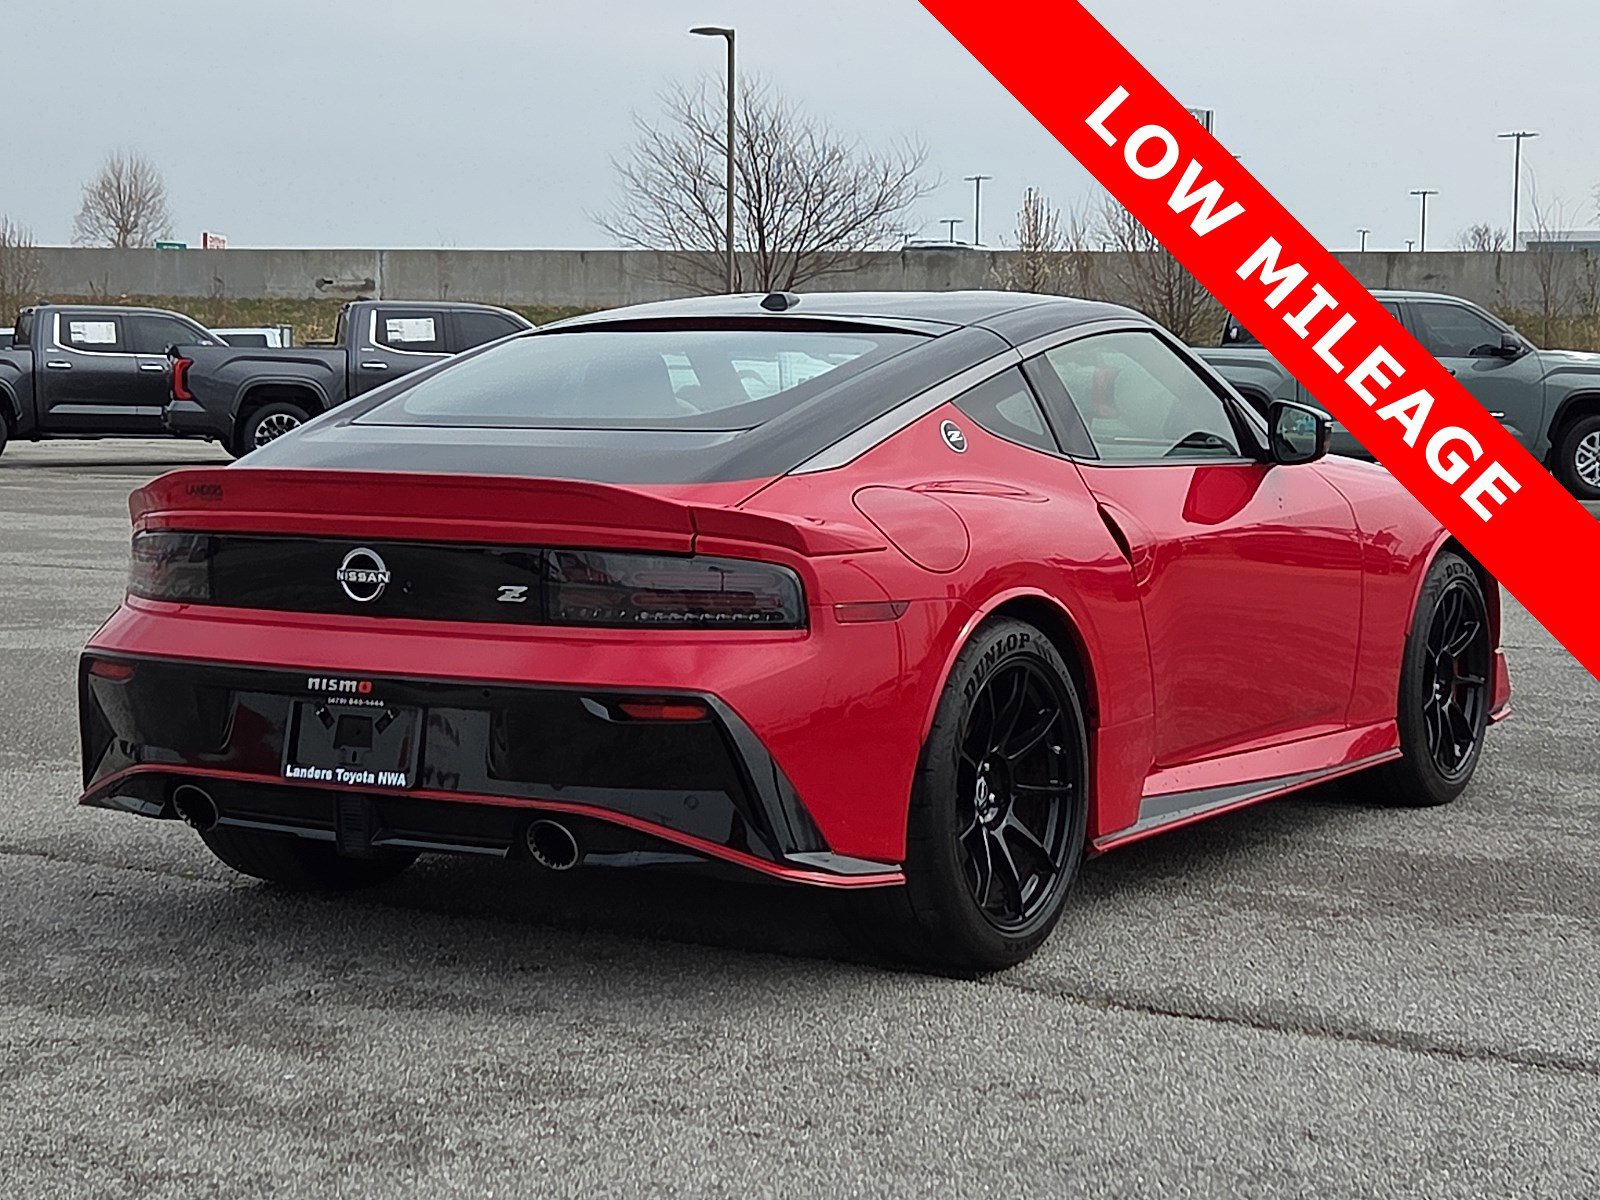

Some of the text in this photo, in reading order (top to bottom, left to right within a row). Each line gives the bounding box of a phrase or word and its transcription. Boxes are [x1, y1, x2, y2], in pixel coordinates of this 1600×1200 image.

[337, 569, 390, 583] NISSAN
[497, 585, 528, 603] Z
[964, 632, 1030, 706] DUNLOP
[286, 764, 406, 787] Landers Toyota NWA
